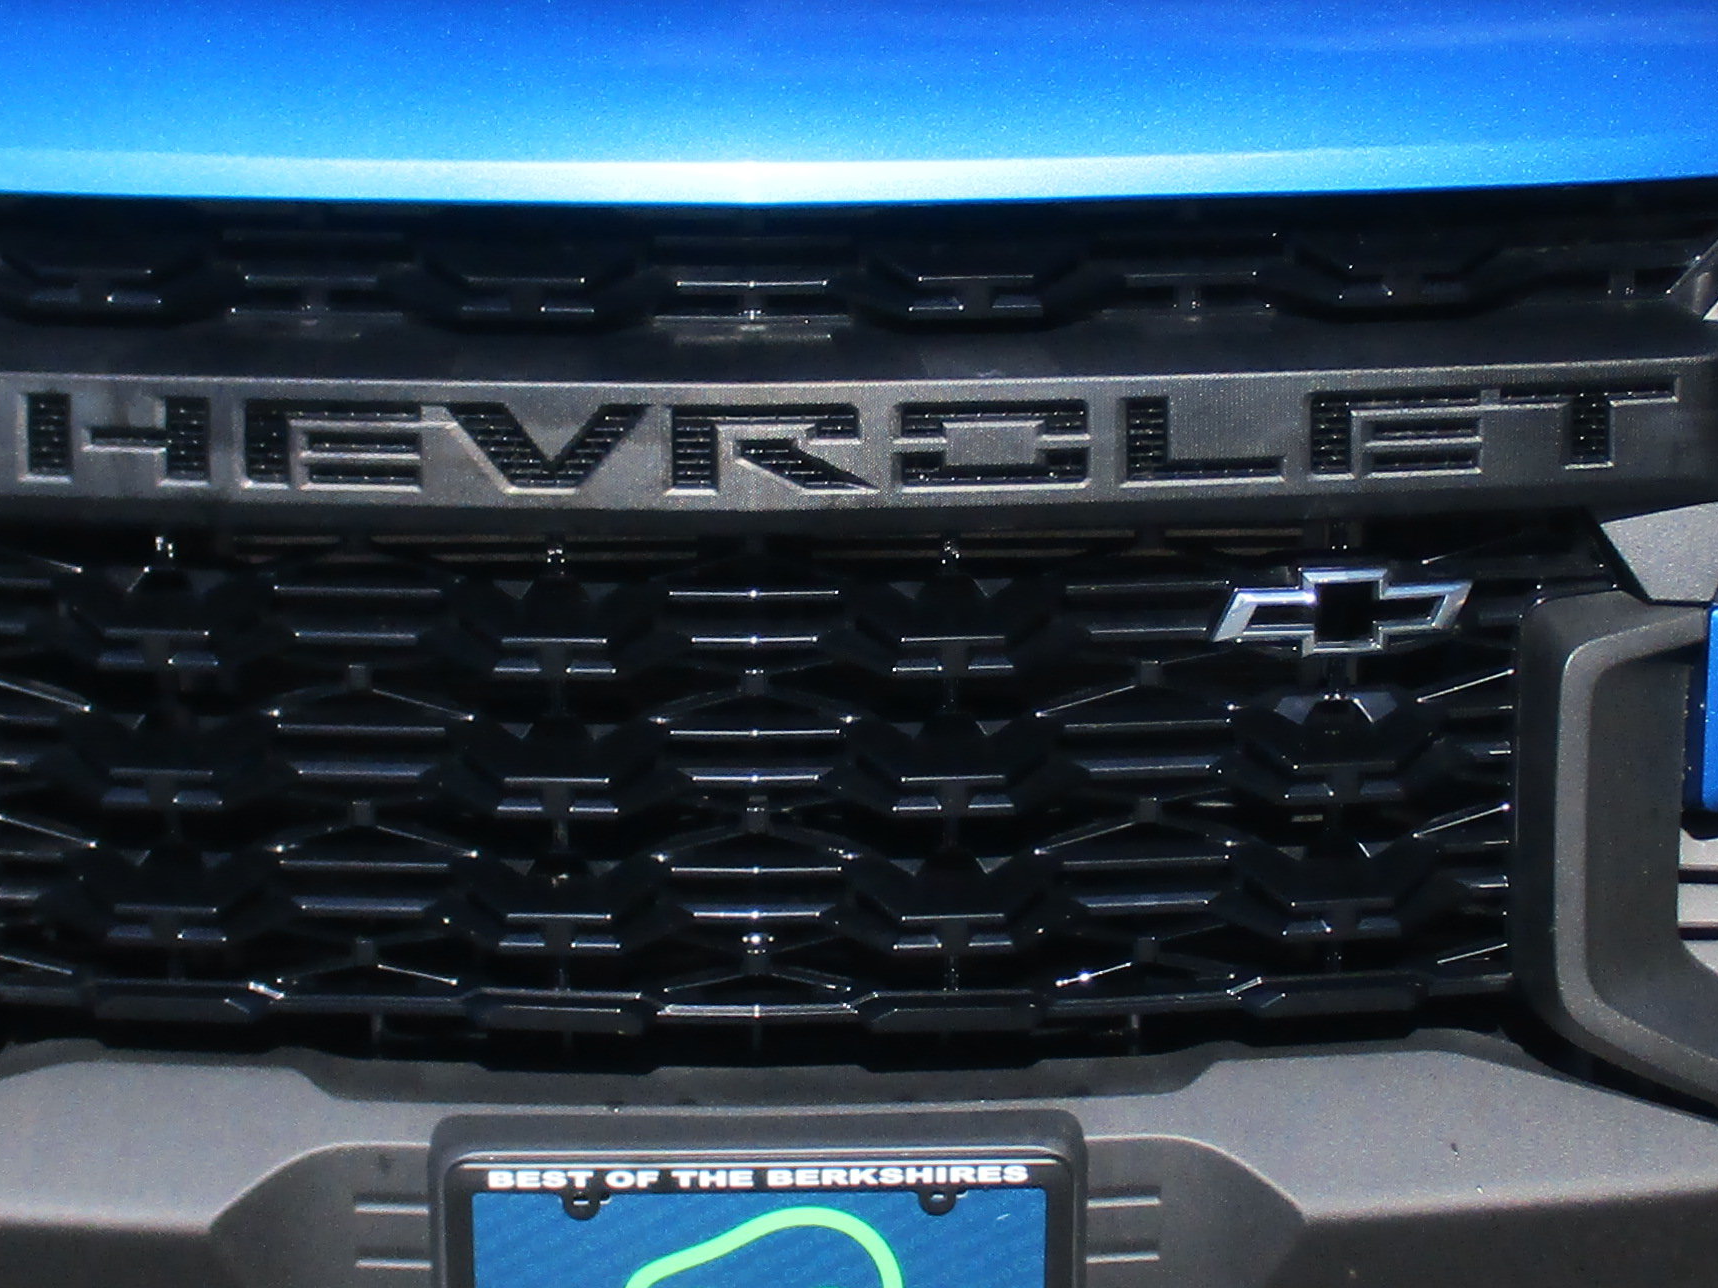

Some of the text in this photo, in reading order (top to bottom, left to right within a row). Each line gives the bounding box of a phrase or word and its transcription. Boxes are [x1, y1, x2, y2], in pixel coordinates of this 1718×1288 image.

[487, 1165, 1029, 1190] BEST OF THE BERKSHIRES
